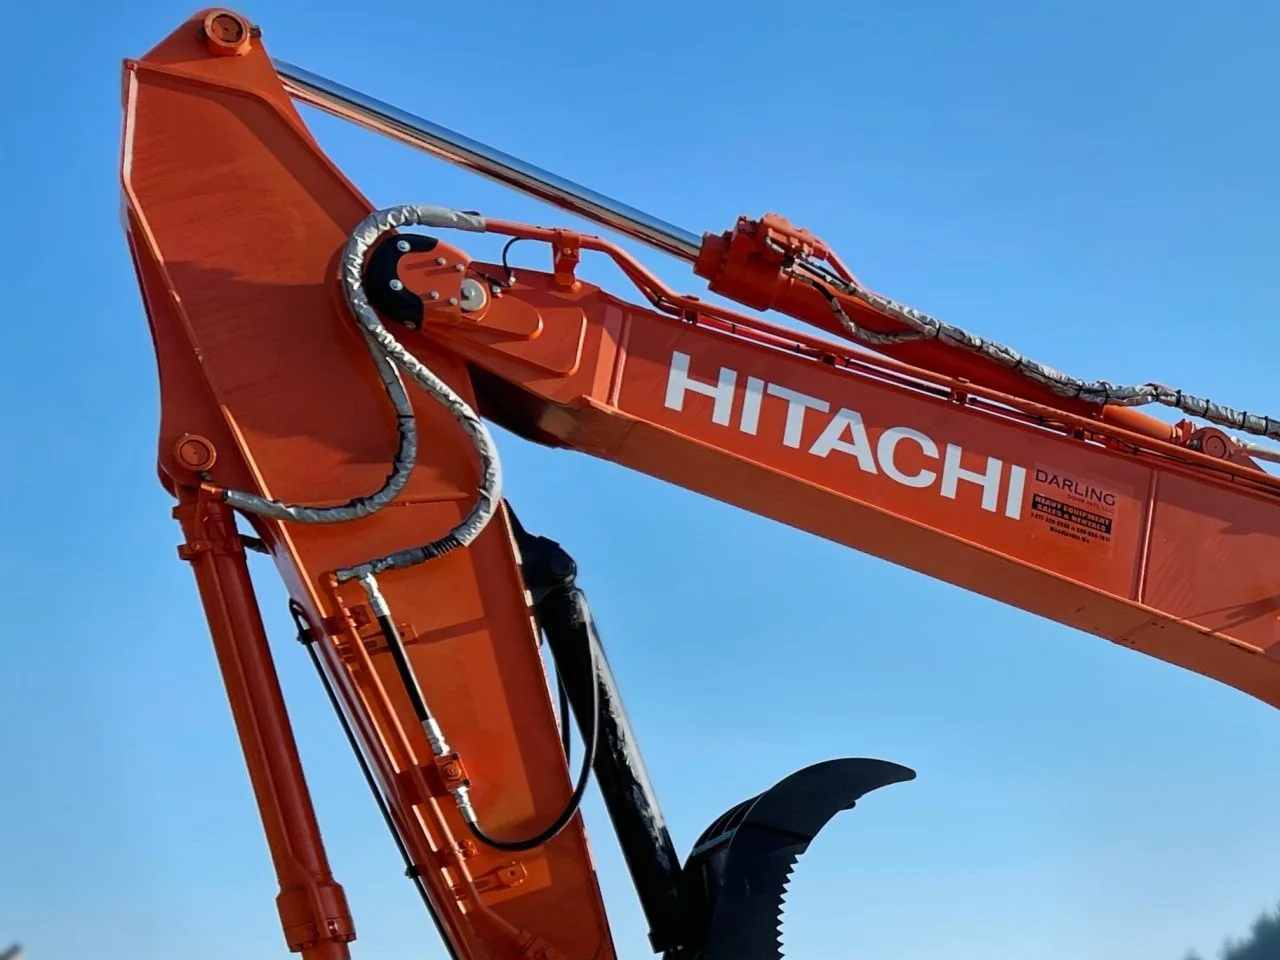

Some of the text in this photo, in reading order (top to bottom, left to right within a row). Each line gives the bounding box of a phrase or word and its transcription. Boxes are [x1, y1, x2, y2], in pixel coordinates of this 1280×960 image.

[664, 350, 1027, 520] HITACHI
[1035, 468, 1116, 506] DARLING
[1034, 496, 1062, 510] HEAVY
[1063, 504, 1110, 525] EQUIPMENT
[1036, 503, 1062, 518] SALES
[1071, 515, 1106, 531] RENTALS
